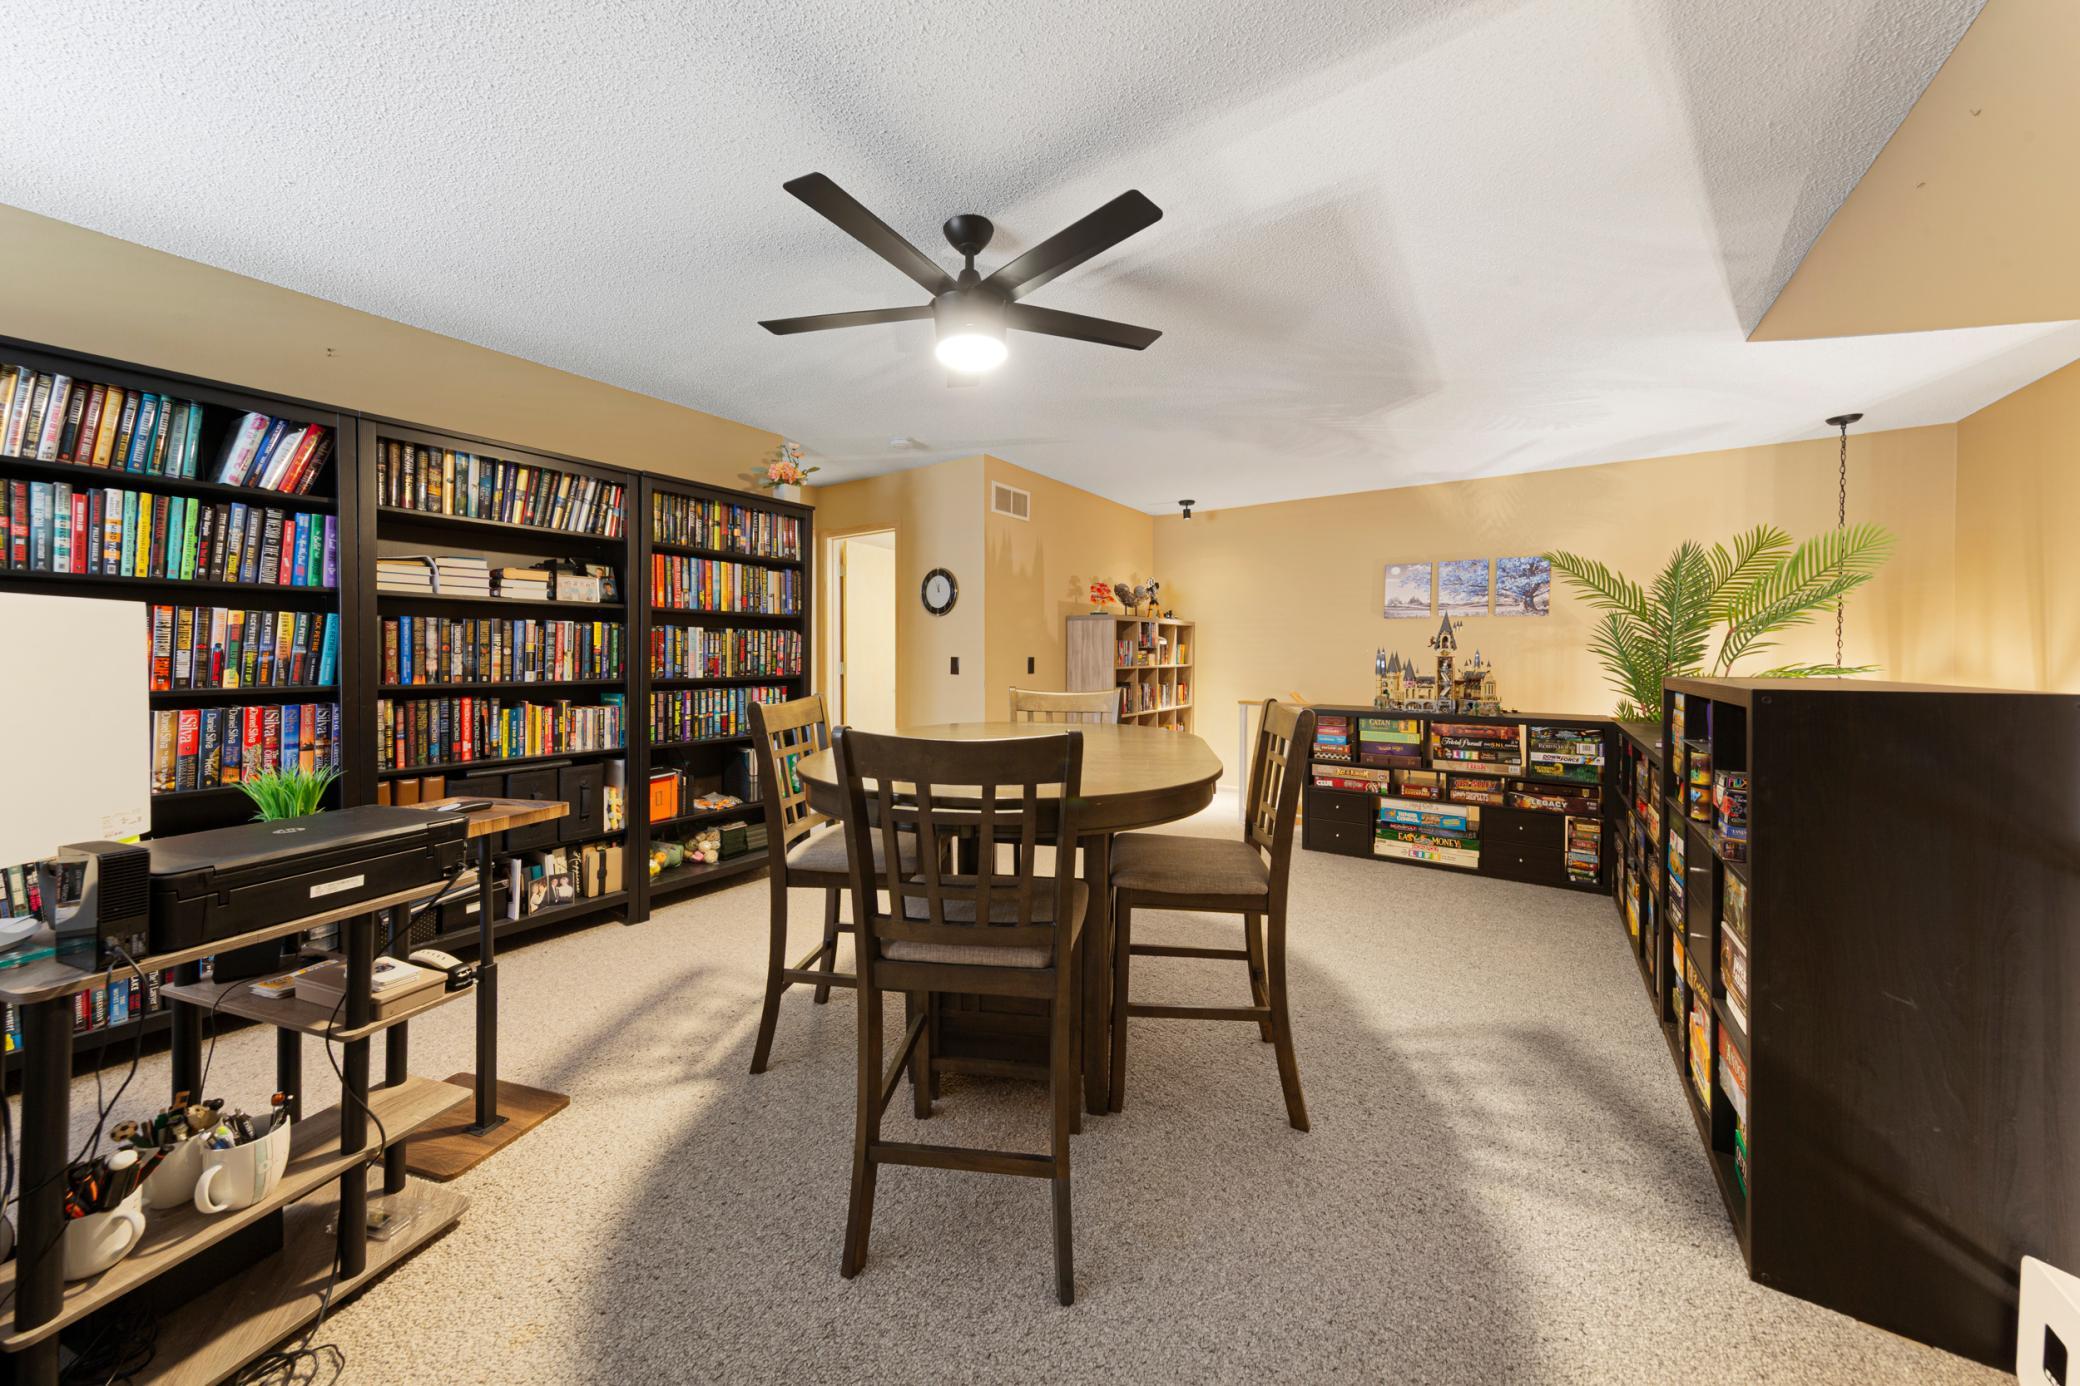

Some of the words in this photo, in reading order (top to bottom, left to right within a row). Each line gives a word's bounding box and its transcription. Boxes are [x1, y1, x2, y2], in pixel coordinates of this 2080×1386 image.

[207, 713, 216, 732] Daniel
[228, 709, 238, 728] Daniel
[205, 733, 215, 748] Silva
[228, 729, 238, 744] Silva
[1530, 798, 1568, 808] LEGACY
[1398, 832, 1416, 842] EASY
[1431, 837, 1460, 848] MONEY
